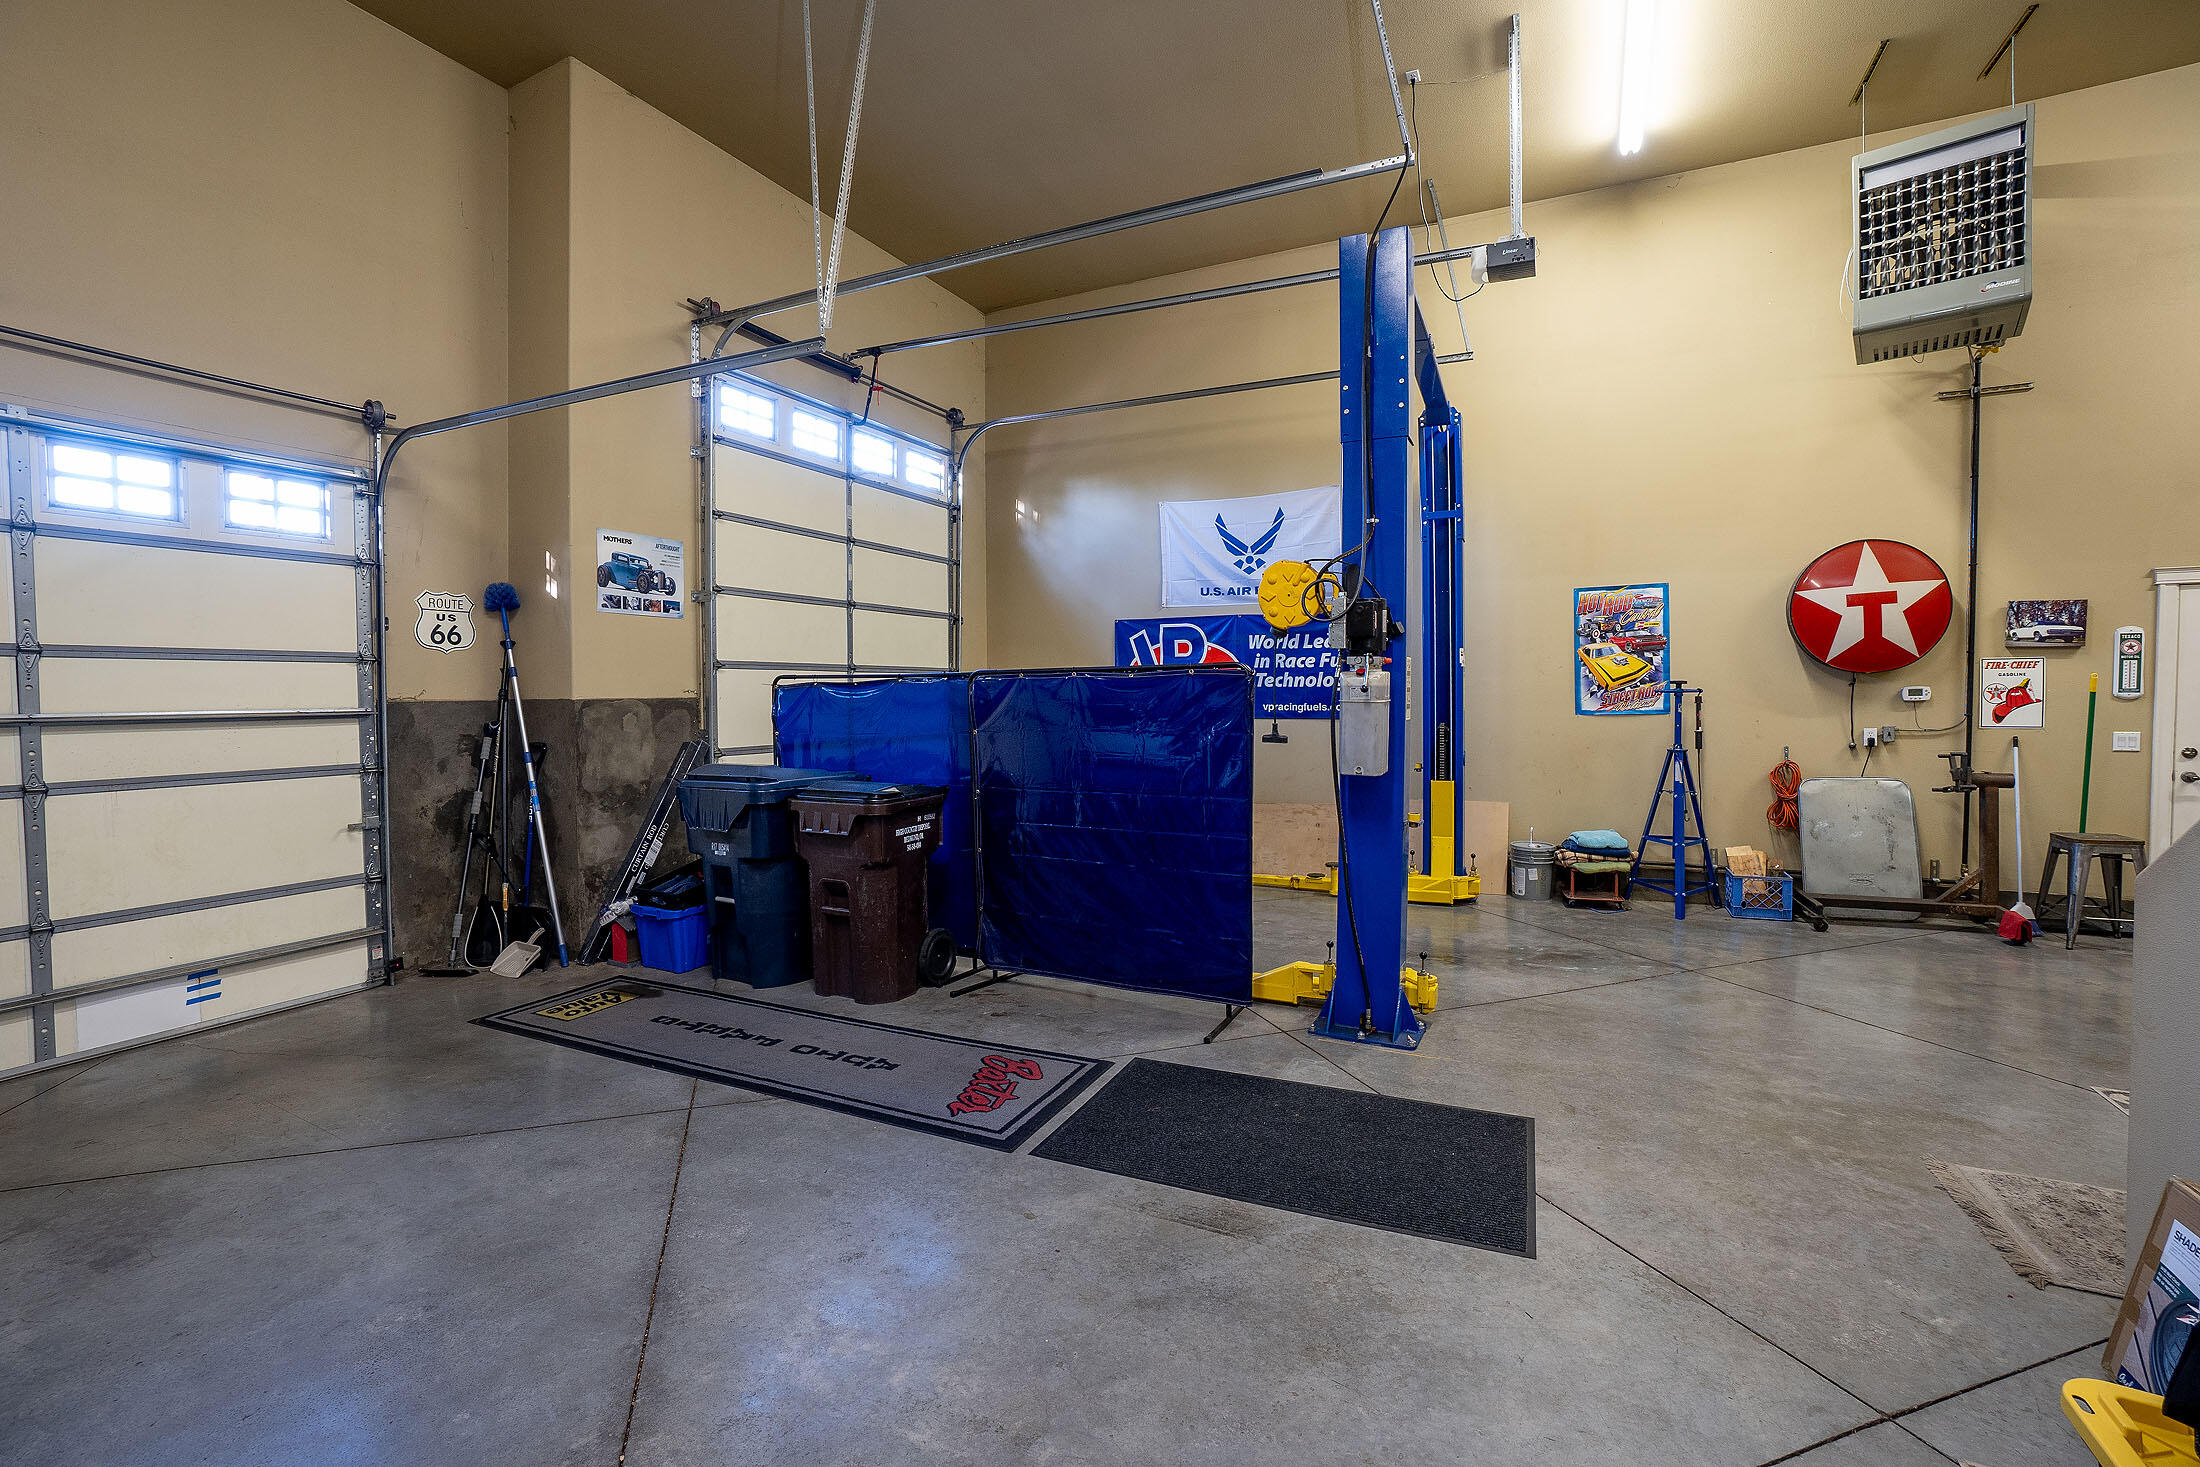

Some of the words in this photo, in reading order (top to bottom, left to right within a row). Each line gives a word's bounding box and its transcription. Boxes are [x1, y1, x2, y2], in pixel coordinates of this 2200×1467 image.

[603, 535, 633, 545] MOTHERS
[1200, 586, 1225, 597] U.S.
[1227, 586, 1252, 596] AIR
[428, 597, 464, 610] ROUTE
[1577, 593, 1604, 616] HOT
[1602, 592, 1634, 616] ROD
[436, 613, 457, 622] US
[430, 623, 462, 645] 66
[1248, 634, 1301, 650] World
[1254, 653, 1270, 668] in
[1275, 653, 1316, 669] Race
[1319, 652, 1339, 668] Fu
[1984, 660, 2040, 670] FIRE-CHIEF
[631, 841, 650, 873] CURTAIN
[646, 824, 658, 841] ROD
[945, 1054, 1044, 1118] Baxter
